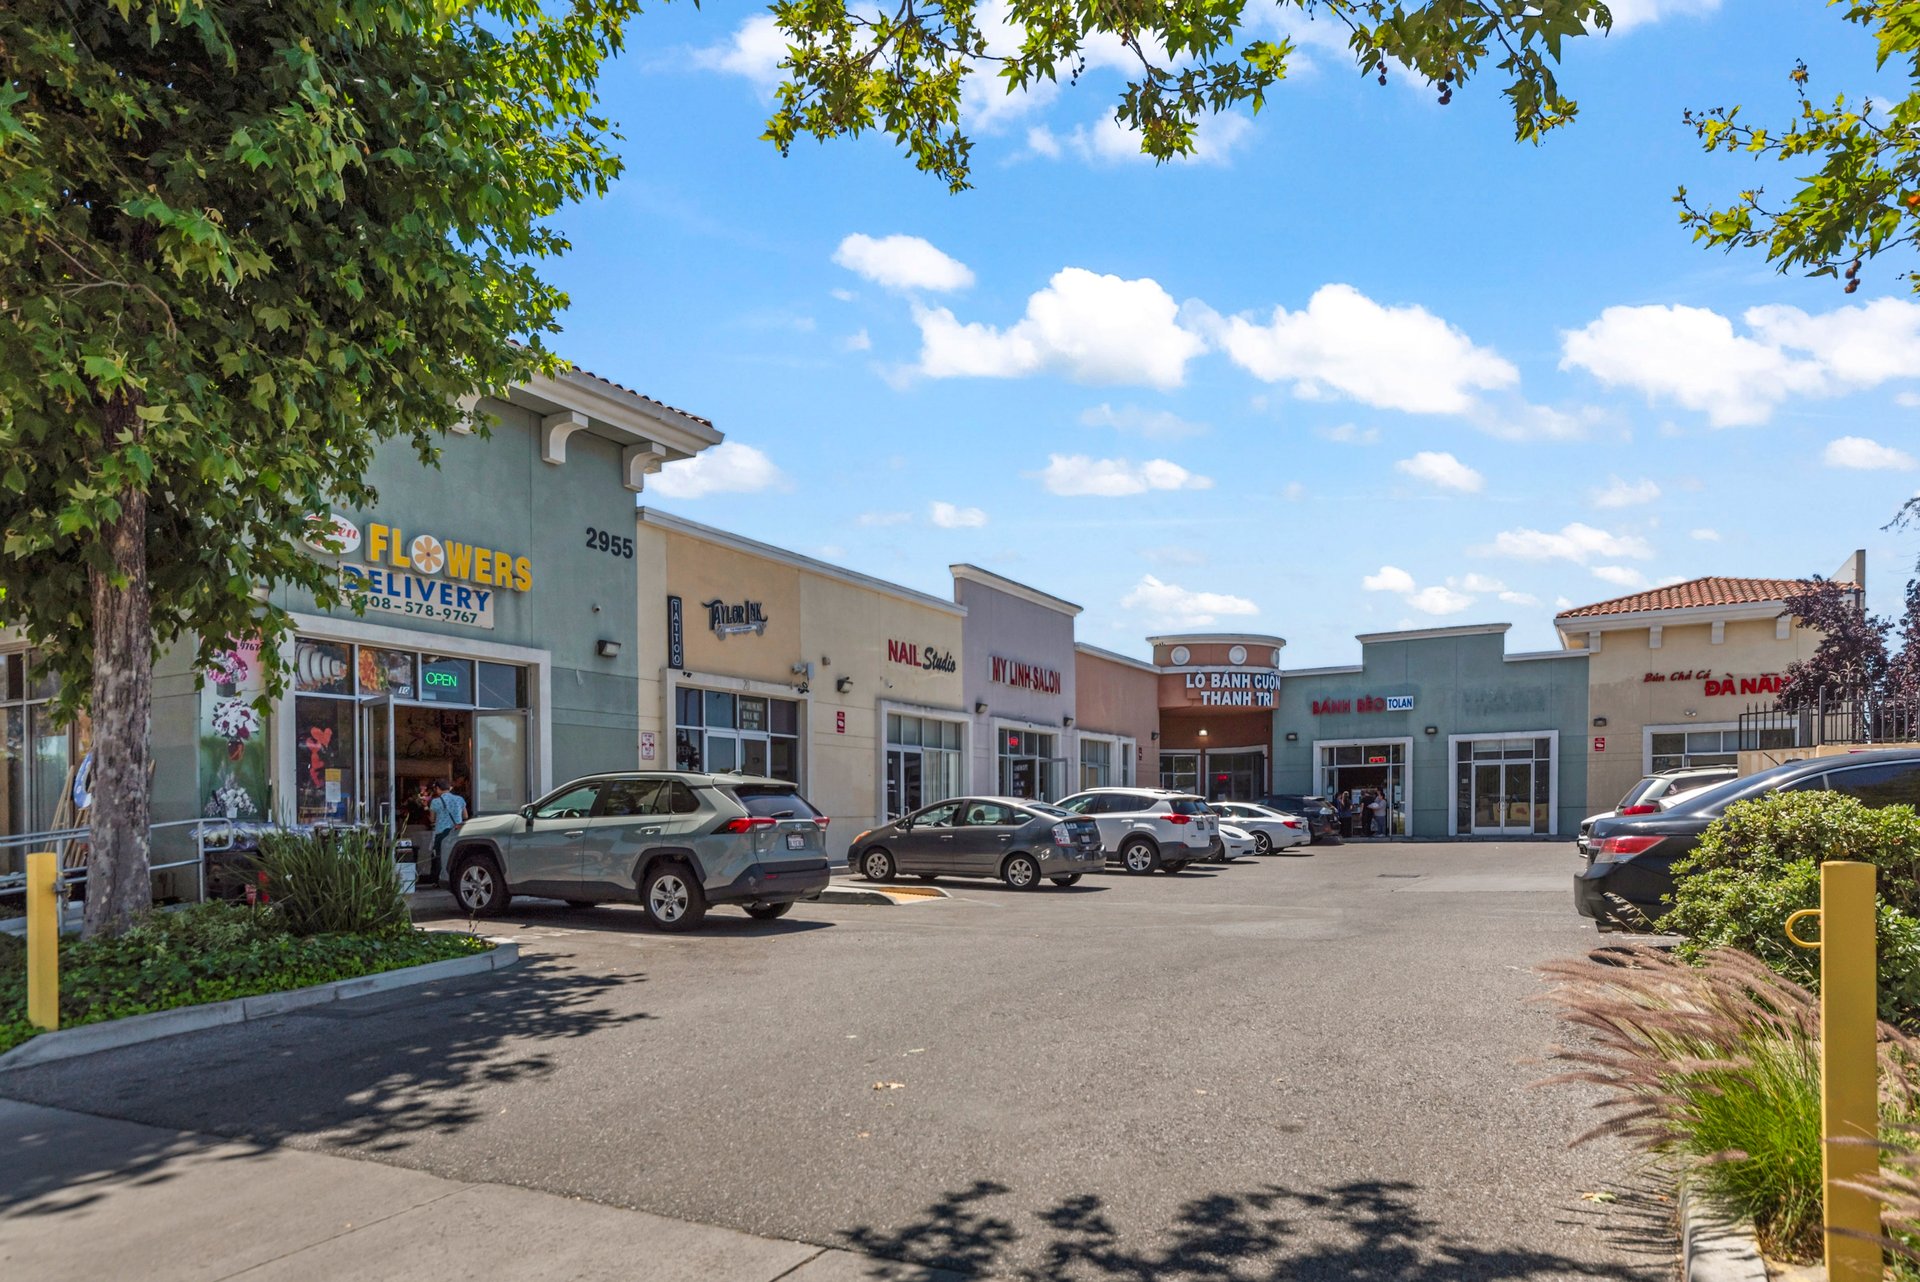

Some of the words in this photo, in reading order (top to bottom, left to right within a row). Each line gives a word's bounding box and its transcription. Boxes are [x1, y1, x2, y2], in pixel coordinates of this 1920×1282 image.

[586, 527, 633, 559] 2955
[343, 565, 490, 612] DELIVERY
[673, 601, 682, 664] TATTOO
[888, 639, 922, 667] NAIL
[922, 646, 956, 673] Studio
[425, 672, 457, 687] OPEN
[992, 656, 1007, 683] MY
[1186, 671, 1206, 688] LÒ
[1211, 671, 1251, 689] BÁNH
[1704, 673, 1737, 696] ĐÀ
[1200, 691, 1252, 706] THANH
[1388, 698, 1413, 709] TOLAN
